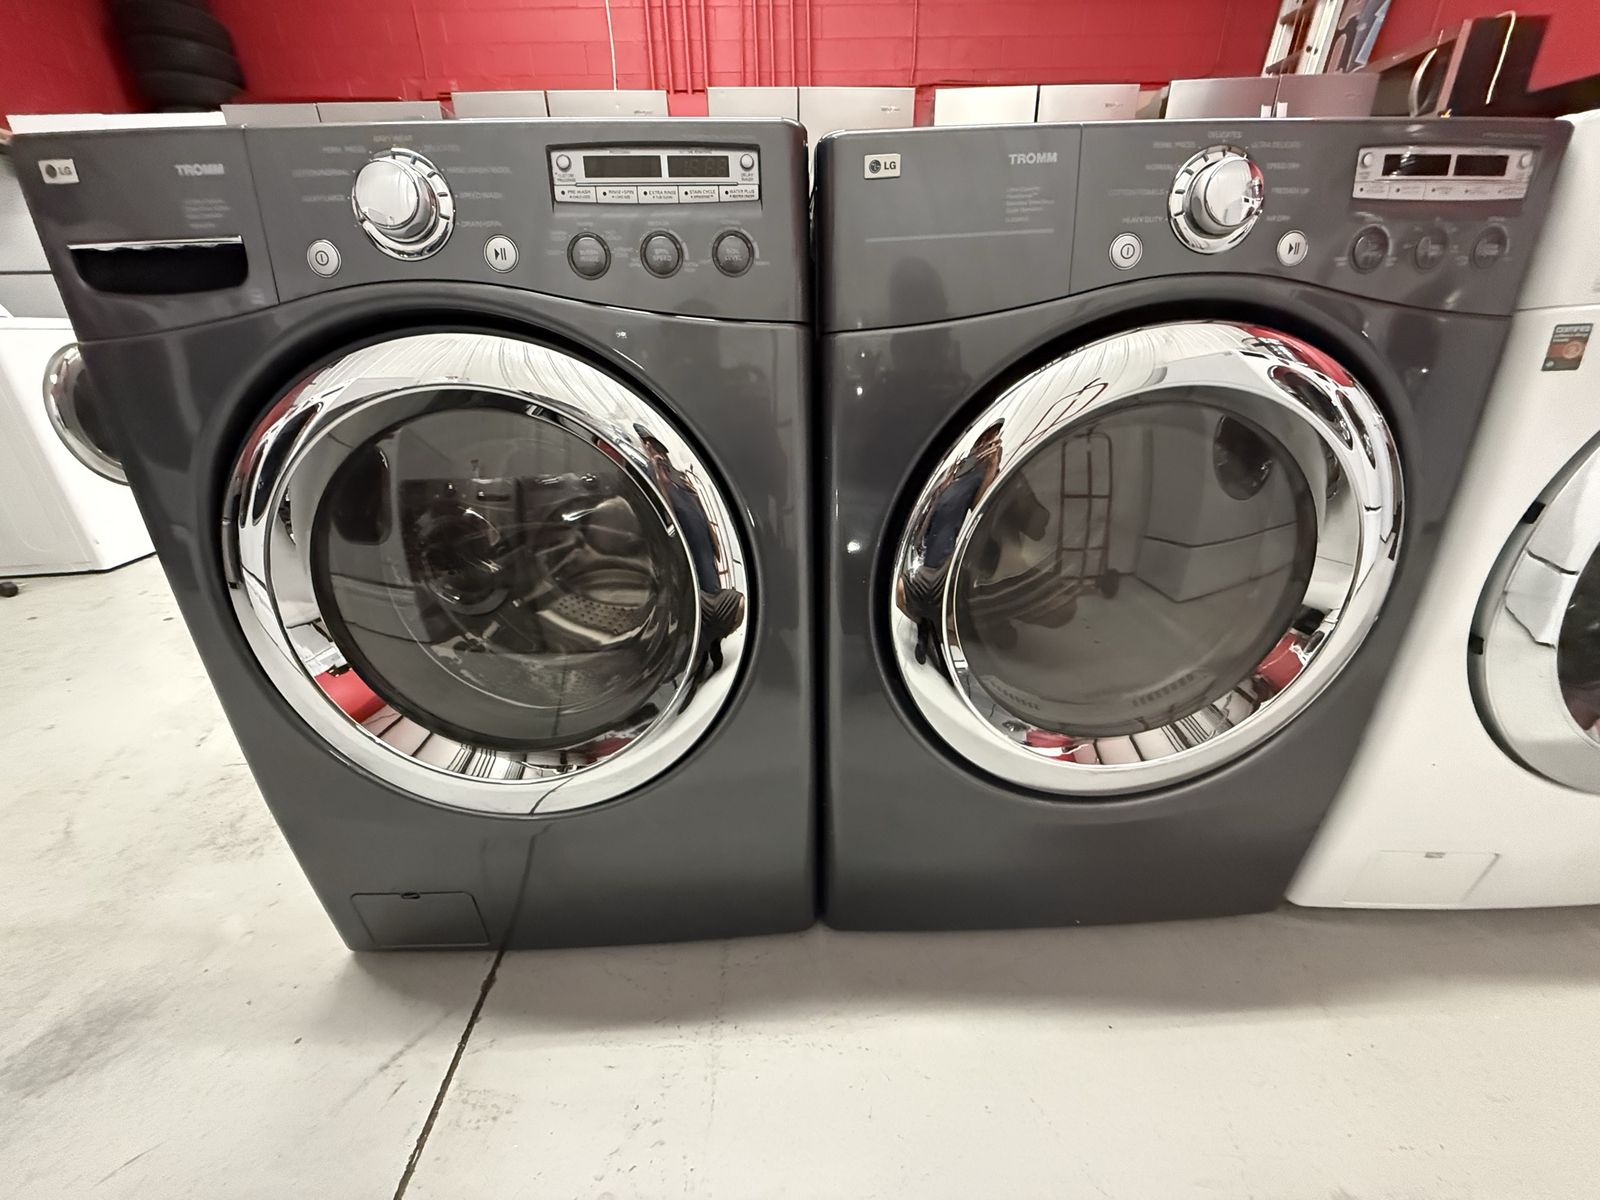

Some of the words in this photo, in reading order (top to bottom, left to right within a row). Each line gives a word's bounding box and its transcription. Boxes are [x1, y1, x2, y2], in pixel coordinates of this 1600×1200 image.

[1008, 152, 1058, 165] TROMM
[58, 165, 73, 176] LG
[174, 163, 226, 176] TROMM
[884, 161, 897, 171] LG
